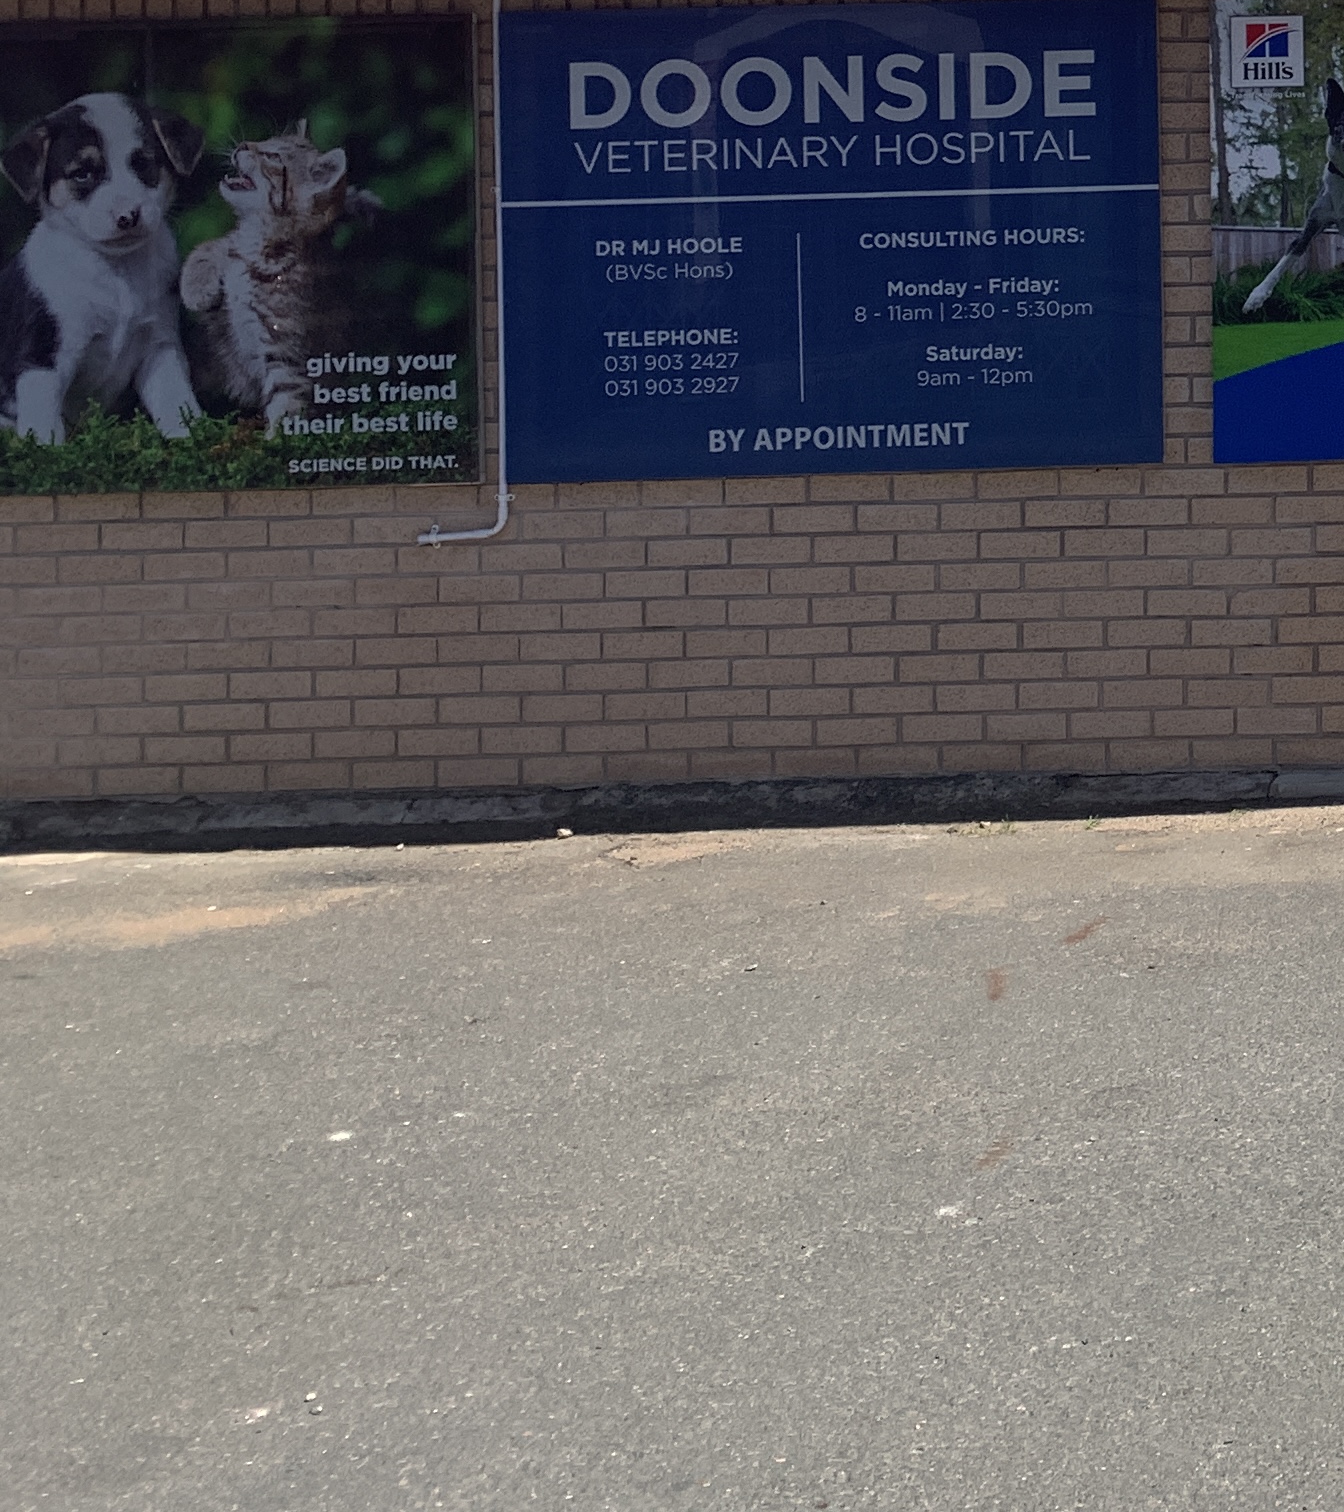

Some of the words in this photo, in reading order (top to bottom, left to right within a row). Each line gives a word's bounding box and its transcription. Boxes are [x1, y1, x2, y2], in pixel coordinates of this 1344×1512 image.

[1242, 61, 1294, 80] Hill's
[568, 49, 1098, 130] DOONSIDE
[1284, 90, 1306, 98] Lives
[573, 134, 859, 174] VETERINARY
[874, 129, 1092, 166] HOSPITAL
[595, 240, 625, 256] DR
[632, 238, 660, 255] MJ
[667, 237, 743, 254] HOOLE
[859, 229, 997, 249] CONSULTING
[1004, 227, 1086, 245] HOURS:
[606, 263, 668, 283] (BVSc
[674, 261, 734, 280] Hons)
[887, 280, 968, 298] Monday
[988, 277, 1060, 296] Friday:
[854, 306, 867, 323] 8
[887, 305, 933, 321] 11am
[951, 302, 995, 320] 2:30
[1016, 301, 1093, 319] 5:30pm
[603, 328, 739, 348] TELEPHONE:
[604, 355, 637, 373] 031
[644, 354, 684, 371] 903
[690, 352, 740, 370] 2427
[926, 343, 1024, 363] Saturday:
[306, 352, 390, 377] giving
[396, 353, 457, 375] your
[604, 379, 638, 397] 031
[645, 378, 684, 395] 903
[691, 376, 740, 394] 2927
[917, 370, 961, 387] 9am
[981, 368, 1033, 387] 12pm
[313, 383, 371, 404] best
[378, 380, 457, 402] friend
[282, 414, 344, 435] their
[352, 412, 409, 433] best
[417, 410, 458, 431] life
[708, 428, 746, 453] BY
[753, 422, 970, 451] APPOINTMENT
[288, 457, 367, 473] SCIENCE
[371, 456, 403, 470] DID
[408, 455, 459, 469] THAT.
